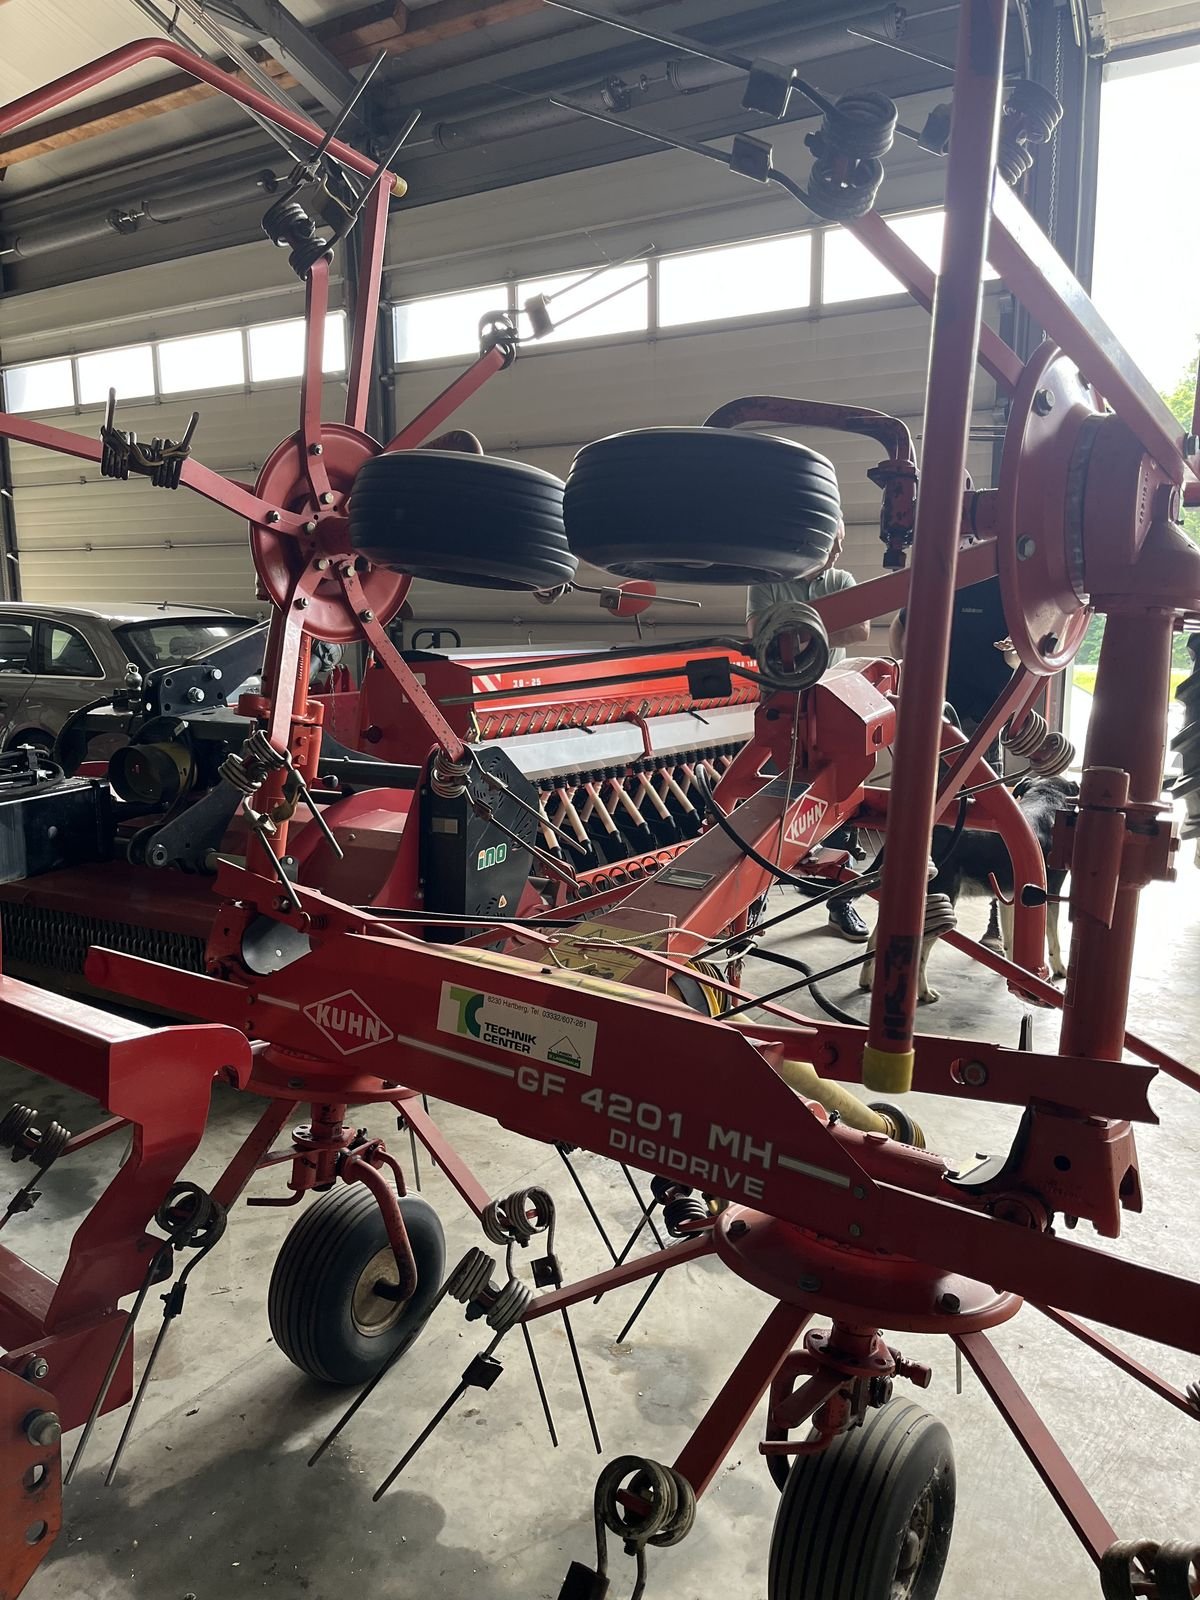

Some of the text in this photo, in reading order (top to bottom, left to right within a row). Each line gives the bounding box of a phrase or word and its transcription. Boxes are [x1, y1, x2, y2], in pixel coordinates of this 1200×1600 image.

[790, 802, 823, 841] KUHN
[487, 995, 502, 1006] 8230
[316, 1003, 381, 1042] KUHN
[484, 1022, 537, 1045] TECHNIK
[483, 1033, 531, 1054] CENTER
[517, 1066, 773, 1170] GF 4201 MH
[609, 1127, 765, 1199] DIGIDRIVE
